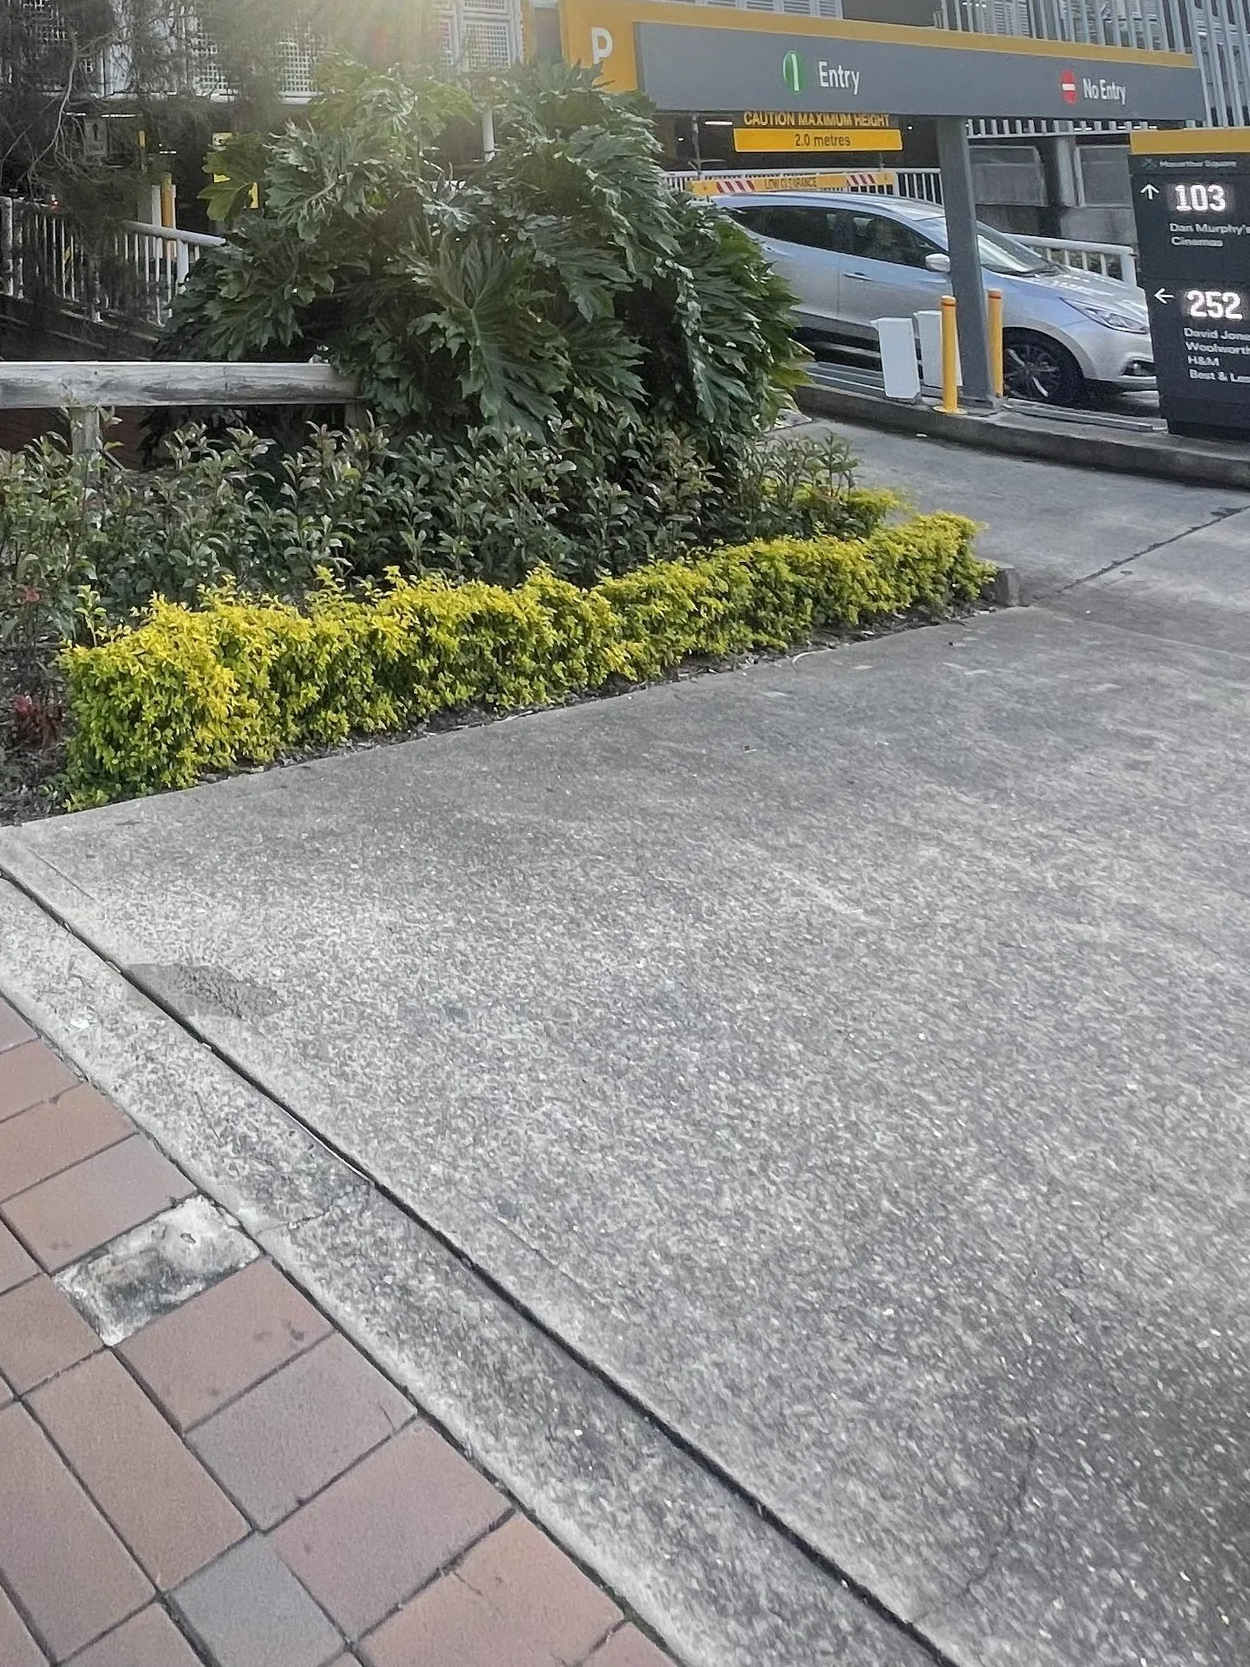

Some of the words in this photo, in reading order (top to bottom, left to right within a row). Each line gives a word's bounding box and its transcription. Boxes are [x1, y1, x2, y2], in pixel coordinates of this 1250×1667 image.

[591, 27, 614, 65] P
[818, 60, 860, 95] Entry
[1082, 77, 1099, 99] No
[1099, 78, 1126, 106] Entry
[743, 111, 796, 126] CAUTION
[798, 112, 853, 126] MAXIMUM
[854, 114, 890, 127] HEIGHT
[794, 133, 810, 147] 2.0
[813, 133, 851, 147] metres
[1174, 183, 1226, 212] 103
[1169, 222, 1194, 233] Dan
[1186, 289, 1244, 320] 252
[1183, 327, 1219, 340] David
[1187, 355, 1220, 367] H&M
[1218, 371, 1229, 382] &
